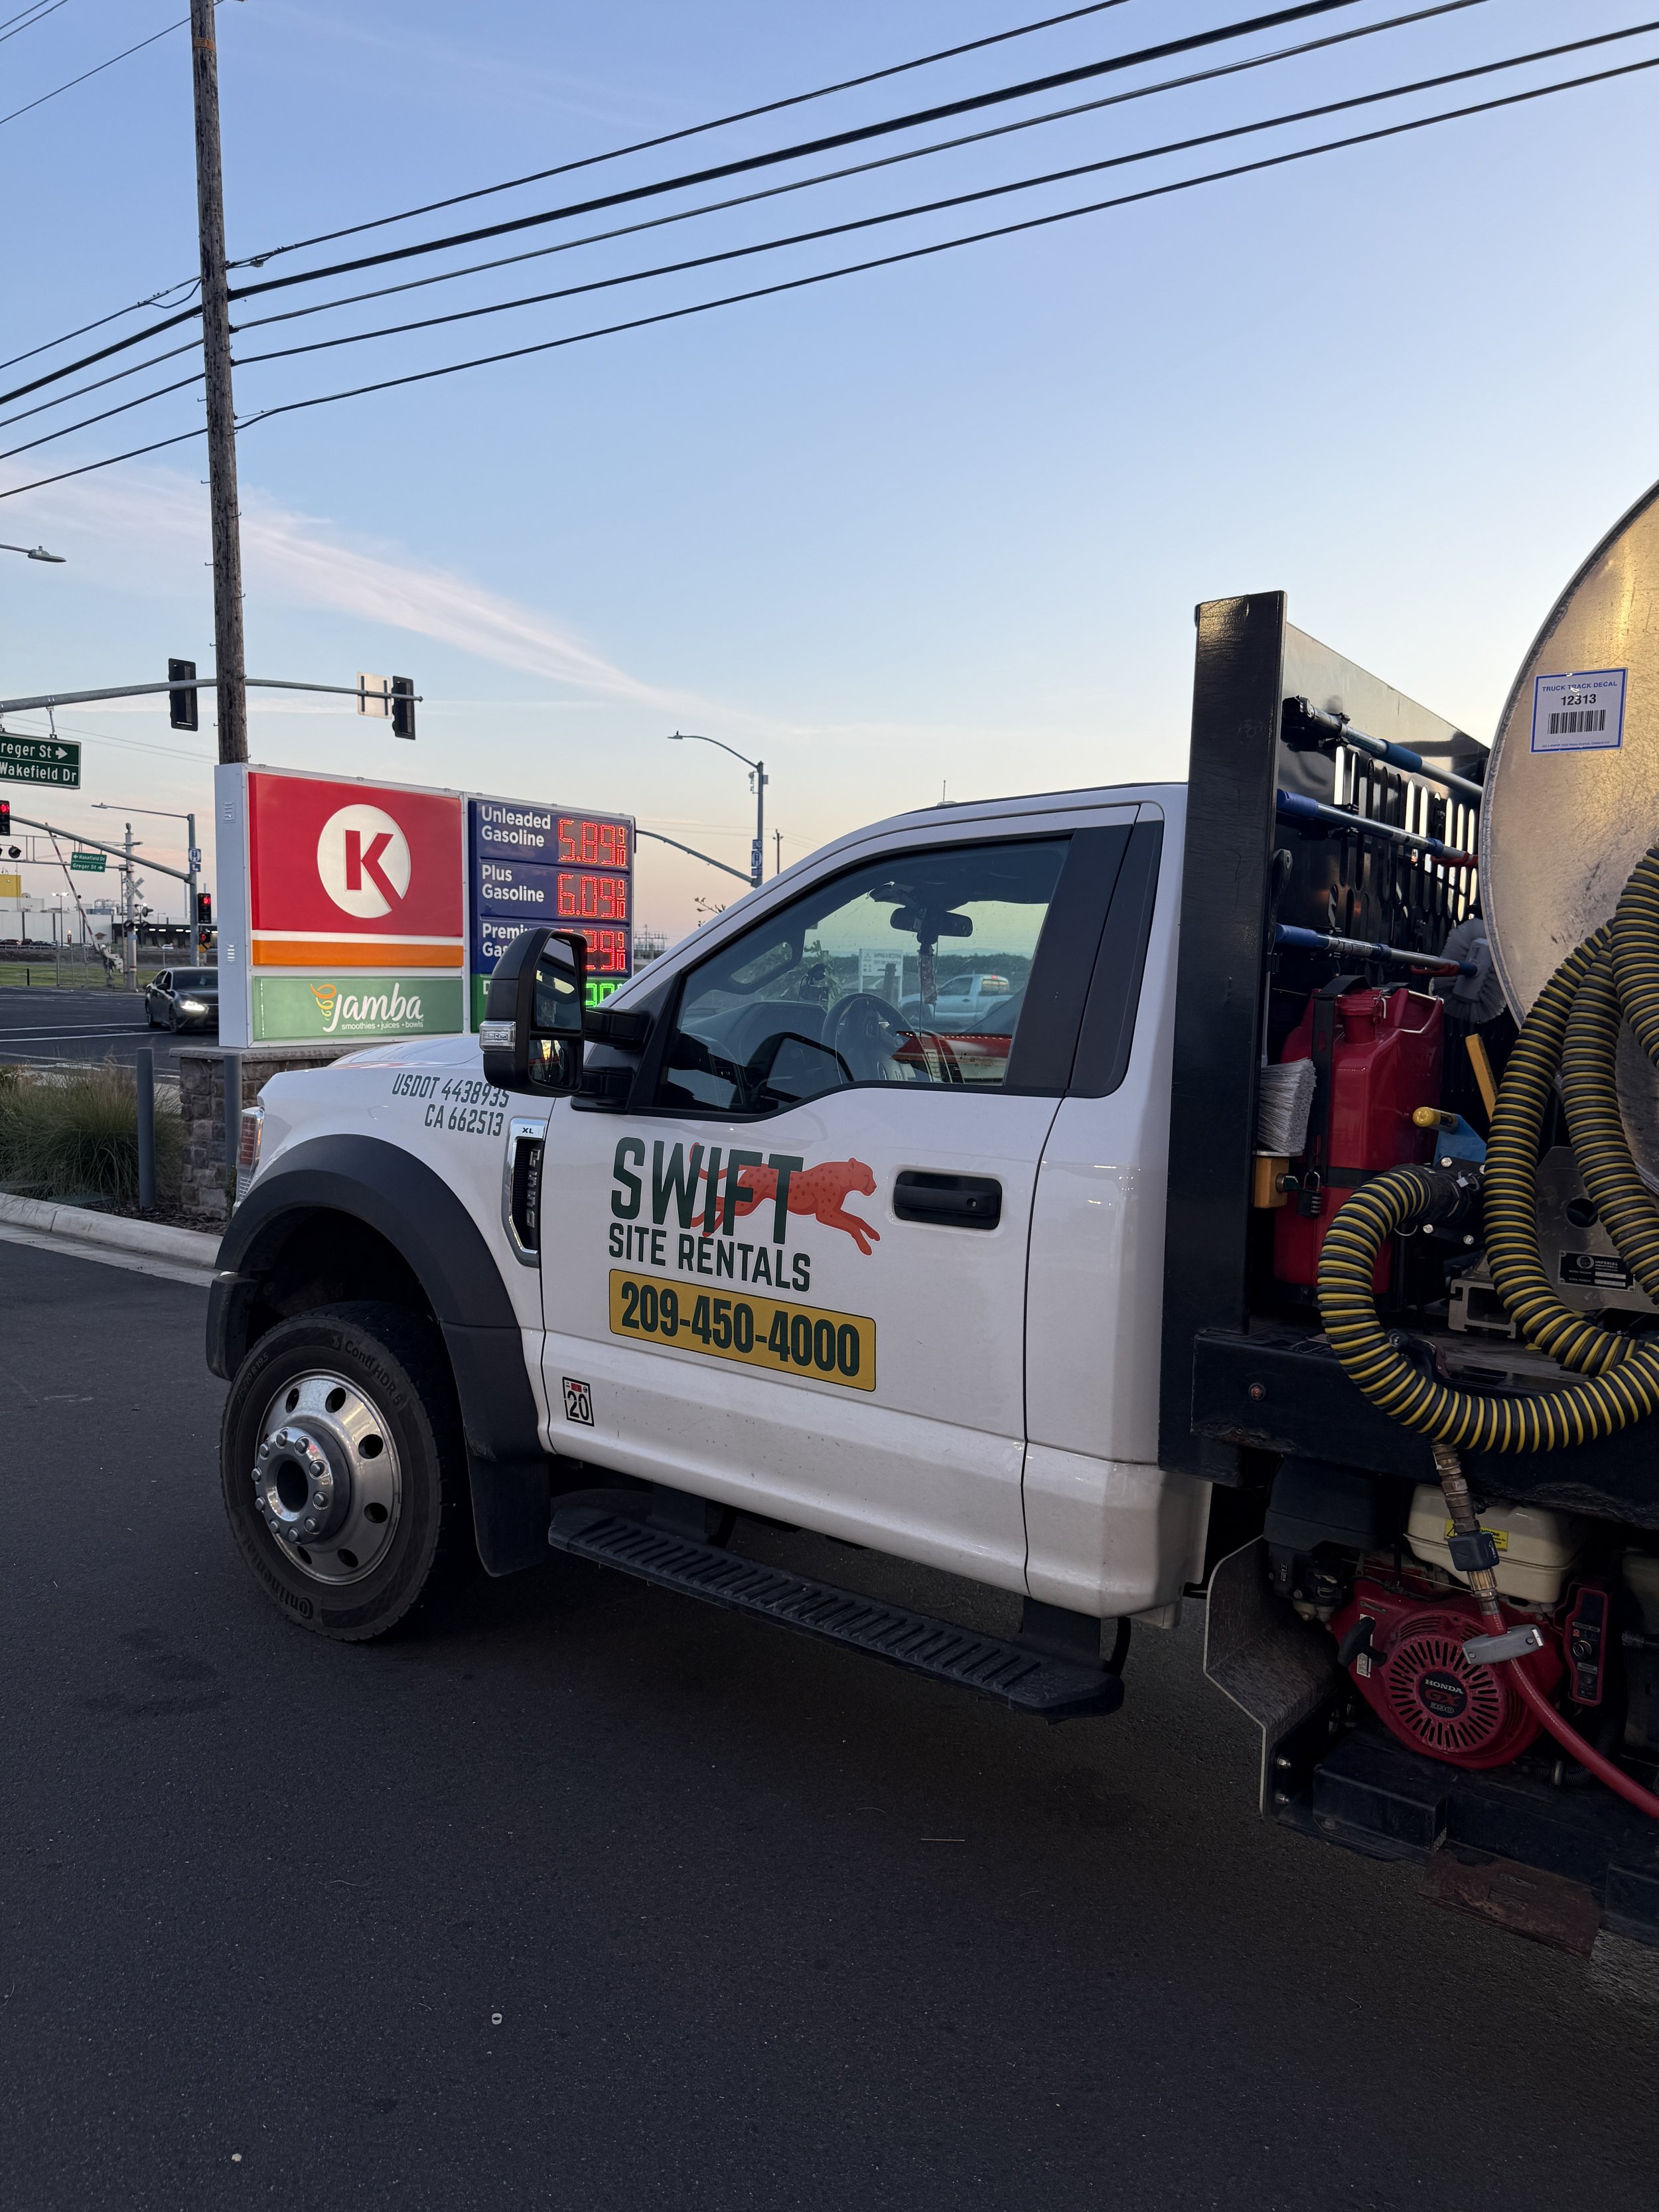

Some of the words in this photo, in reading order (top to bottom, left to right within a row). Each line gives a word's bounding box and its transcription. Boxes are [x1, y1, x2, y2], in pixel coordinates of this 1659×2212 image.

[1561, 694, 1597, 705] 12313
[0, 743, 35, 758] reger
[39, 745, 52, 758] St
[0, 762, 58, 780] Wakefield
[62, 769, 77, 782] Dr
[482, 806, 551, 830] Unleaded
[558, 818, 616, 866] 5.89
[482, 825, 545, 848] Gasoline
[345, 830, 401, 910] K
[482, 865, 512, 882] Plus
[558, 873, 616, 919] 6.09
[482, 884, 545, 903] Gasoline
[482, 923, 529, 939] Premi
[323, 982, 424, 1033] jamba
[381, 1021, 400, 1031] juices
[392, 1073, 441, 1099] USDOT
[441, 1078, 510, 1108] 4438935
[424, 1104, 445, 1129] CA
[448, 1106, 504, 1137] 662513
[611, 1137, 804, 1245] SWIFT
[609, 1222, 667, 1267] SITE
[678, 1233, 811, 1292] RENTALS
[621, 1281, 860, 1376] 209-450-4000
[346, 1341, 375, 1369] Conti
[371, 1363, 396, 1397] HDR
[567, 1390, 589, 1420] 20
[1425, 1678, 1464, 1694] HONDA
[1425, 1688, 1461, 1707] GX
[1429, 1702, 1455, 1714] 390
